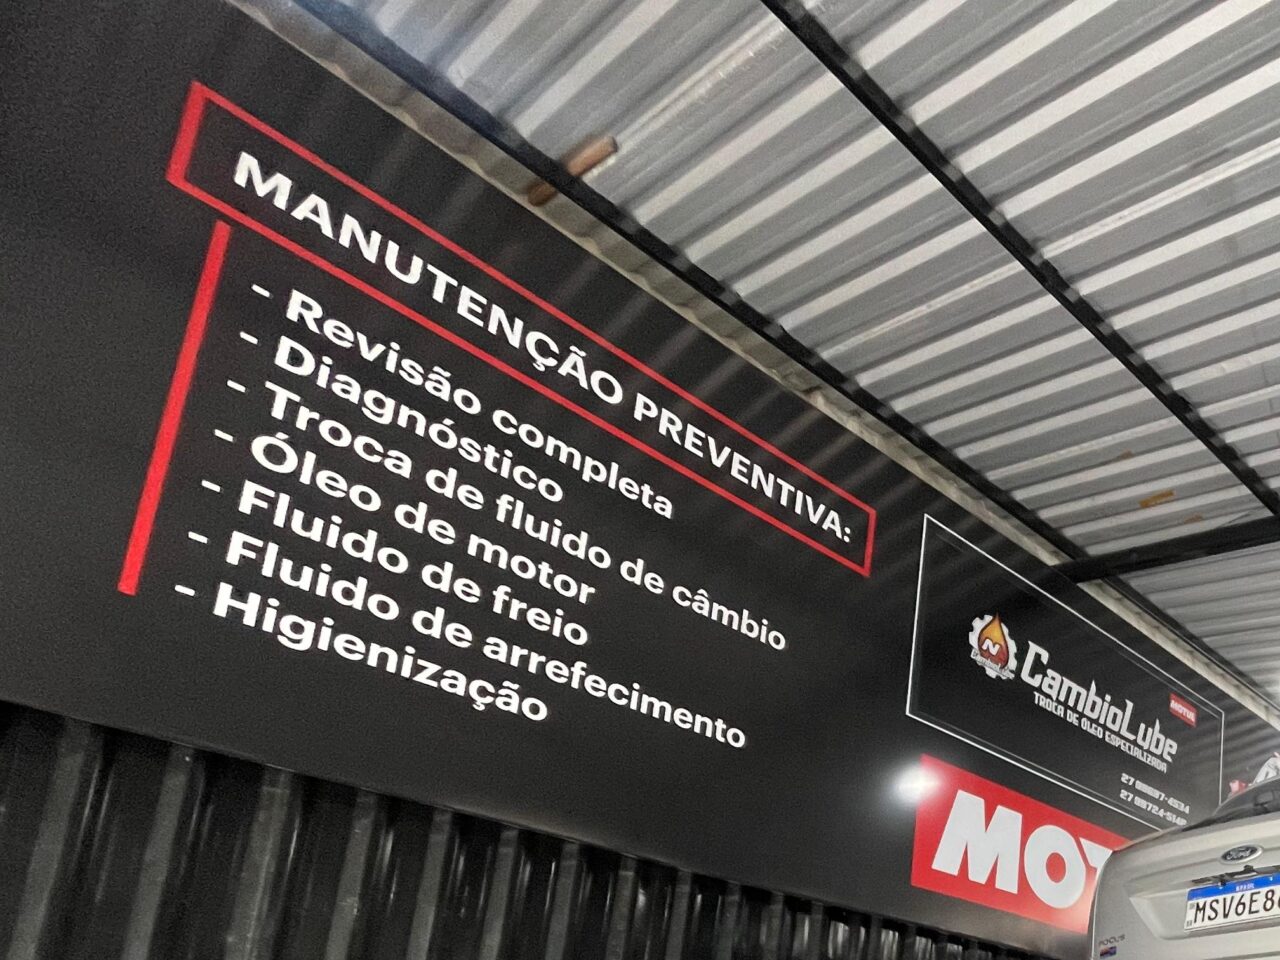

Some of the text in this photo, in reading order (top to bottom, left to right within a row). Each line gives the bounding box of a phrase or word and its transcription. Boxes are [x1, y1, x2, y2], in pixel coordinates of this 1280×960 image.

[233, 151, 851, 543] MANUTENÇÃO PREVENTIVA:
[274, 335, 564, 502] Diagnóstico
[285, 288, 482, 415] Revisão
[492, 409, 673, 520] completa
[238, 479, 409, 574] Fluido
[421, 561, 482, 604] de
[492, 584, 588, 646] freio
[250, 431, 382, 512] Óleo
[394, 501, 456, 545] de
[467, 533, 596, 605] motor
[264, 380, 413, 479] Troca
[425, 467, 485, 510] de
[495, 493, 612, 569] fluido
[619, 558, 665, 595] de
[672, 585, 786, 651] câmbio
[212, 581, 548, 721] Higienização
[225, 530, 400, 621] Fluido
[411, 606, 473, 649] de
[482, 636, 746, 748] arrefecimento
[1020, 641, 1178, 763] CambioLube
[1169, 699, 1196, 723] MOTUL
[1033, 691, 1064, 719] TROCA
[1066, 710, 1079, 727] DE
[1104, 730, 1168, 774] ESPECIALIZADA
[1120, 789, 1133, 802] 27
[1121, 772, 1135, 786] 27
[1226, 845, 1253, 860] Ford
